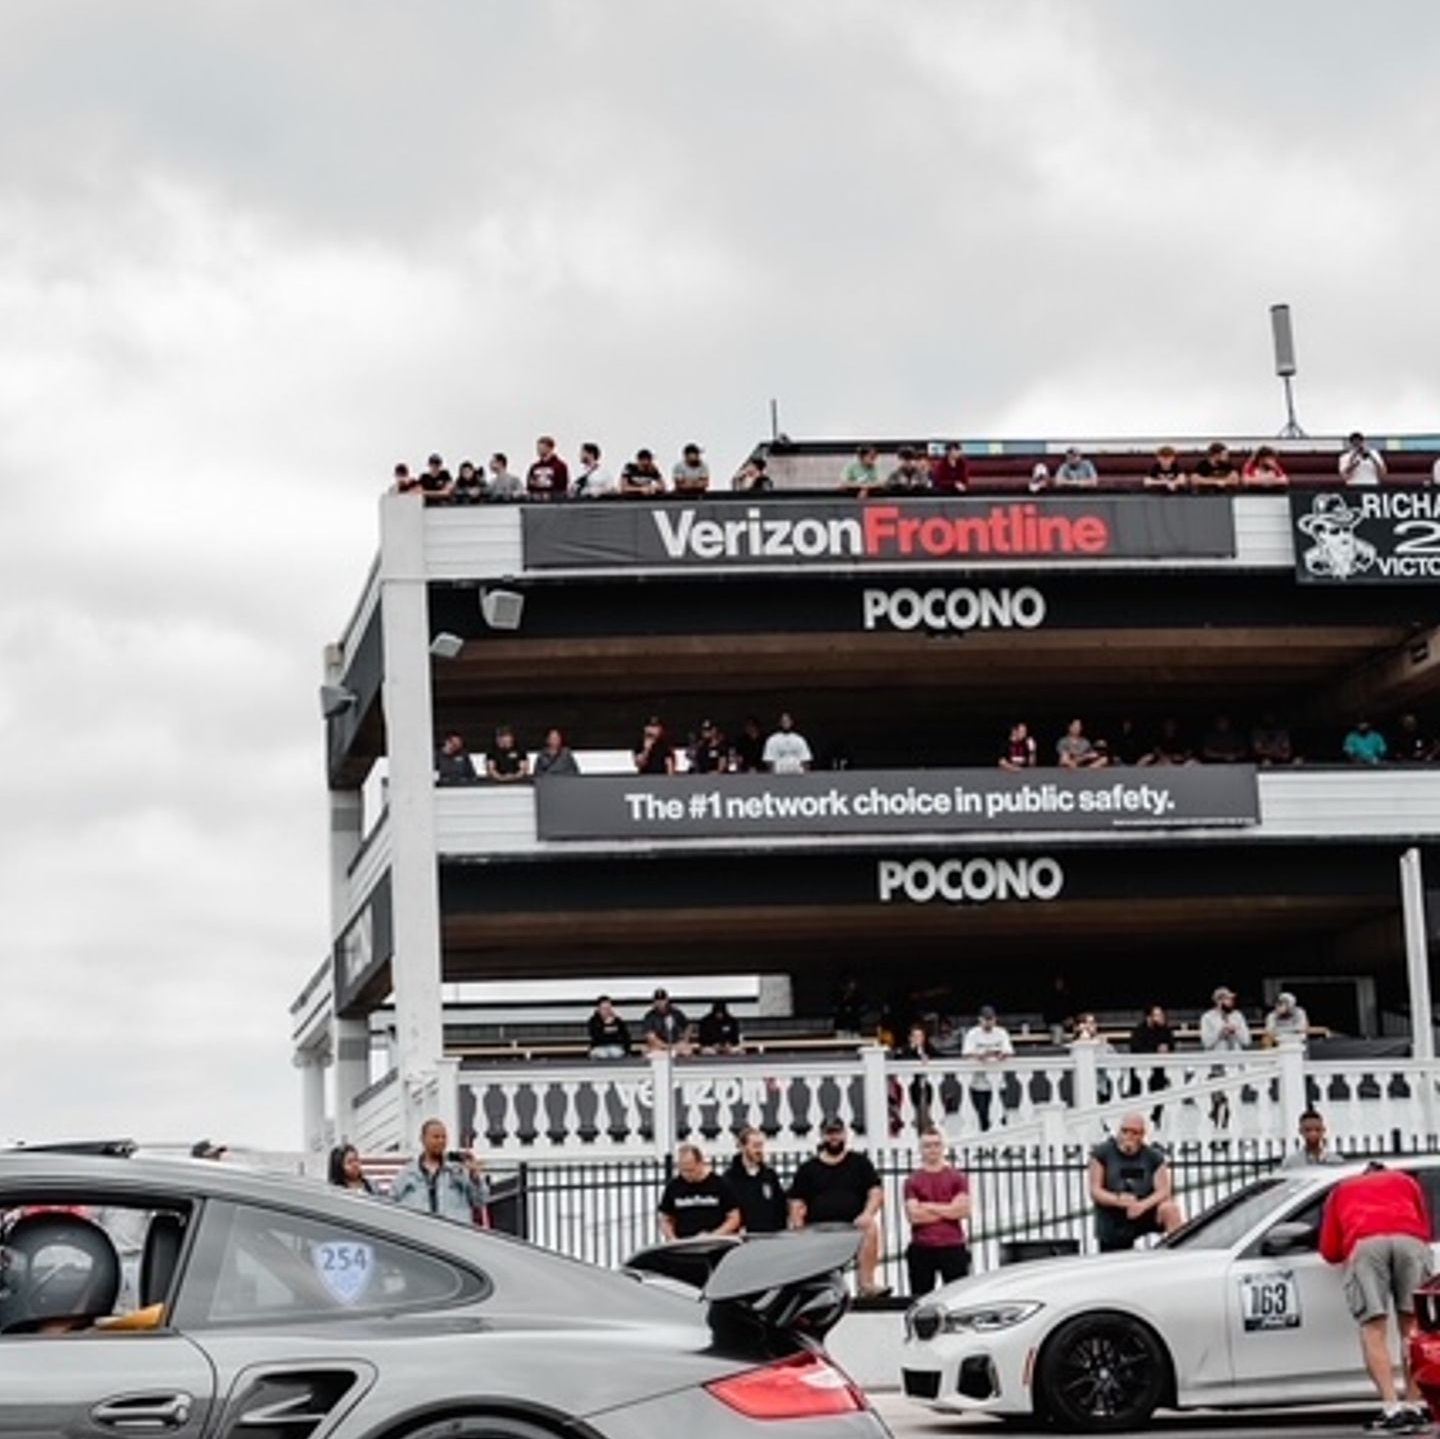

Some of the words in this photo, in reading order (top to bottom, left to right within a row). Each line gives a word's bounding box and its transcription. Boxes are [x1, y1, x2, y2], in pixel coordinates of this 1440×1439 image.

[652, 510, 861, 558] Verizon
[862, 505, 1108, 556] Frontline
[863, 587, 1046, 630] POCONO
[625, 793, 684, 820] The
[688, 792, 722, 819] #1
[726, 788, 850, 818] network
[853, 787, 952, 816] choice
[954, 786, 983, 813] in
[986, 784, 1074, 819] public
[1079, 783, 1174, 815] safety.
[879, 858, 1064, 902] POCONO
[614, 1075, 768, 1107] veizon
[321, 1247, 366, 1271] 254
[1251, 1283, 1287, 1316] 163
